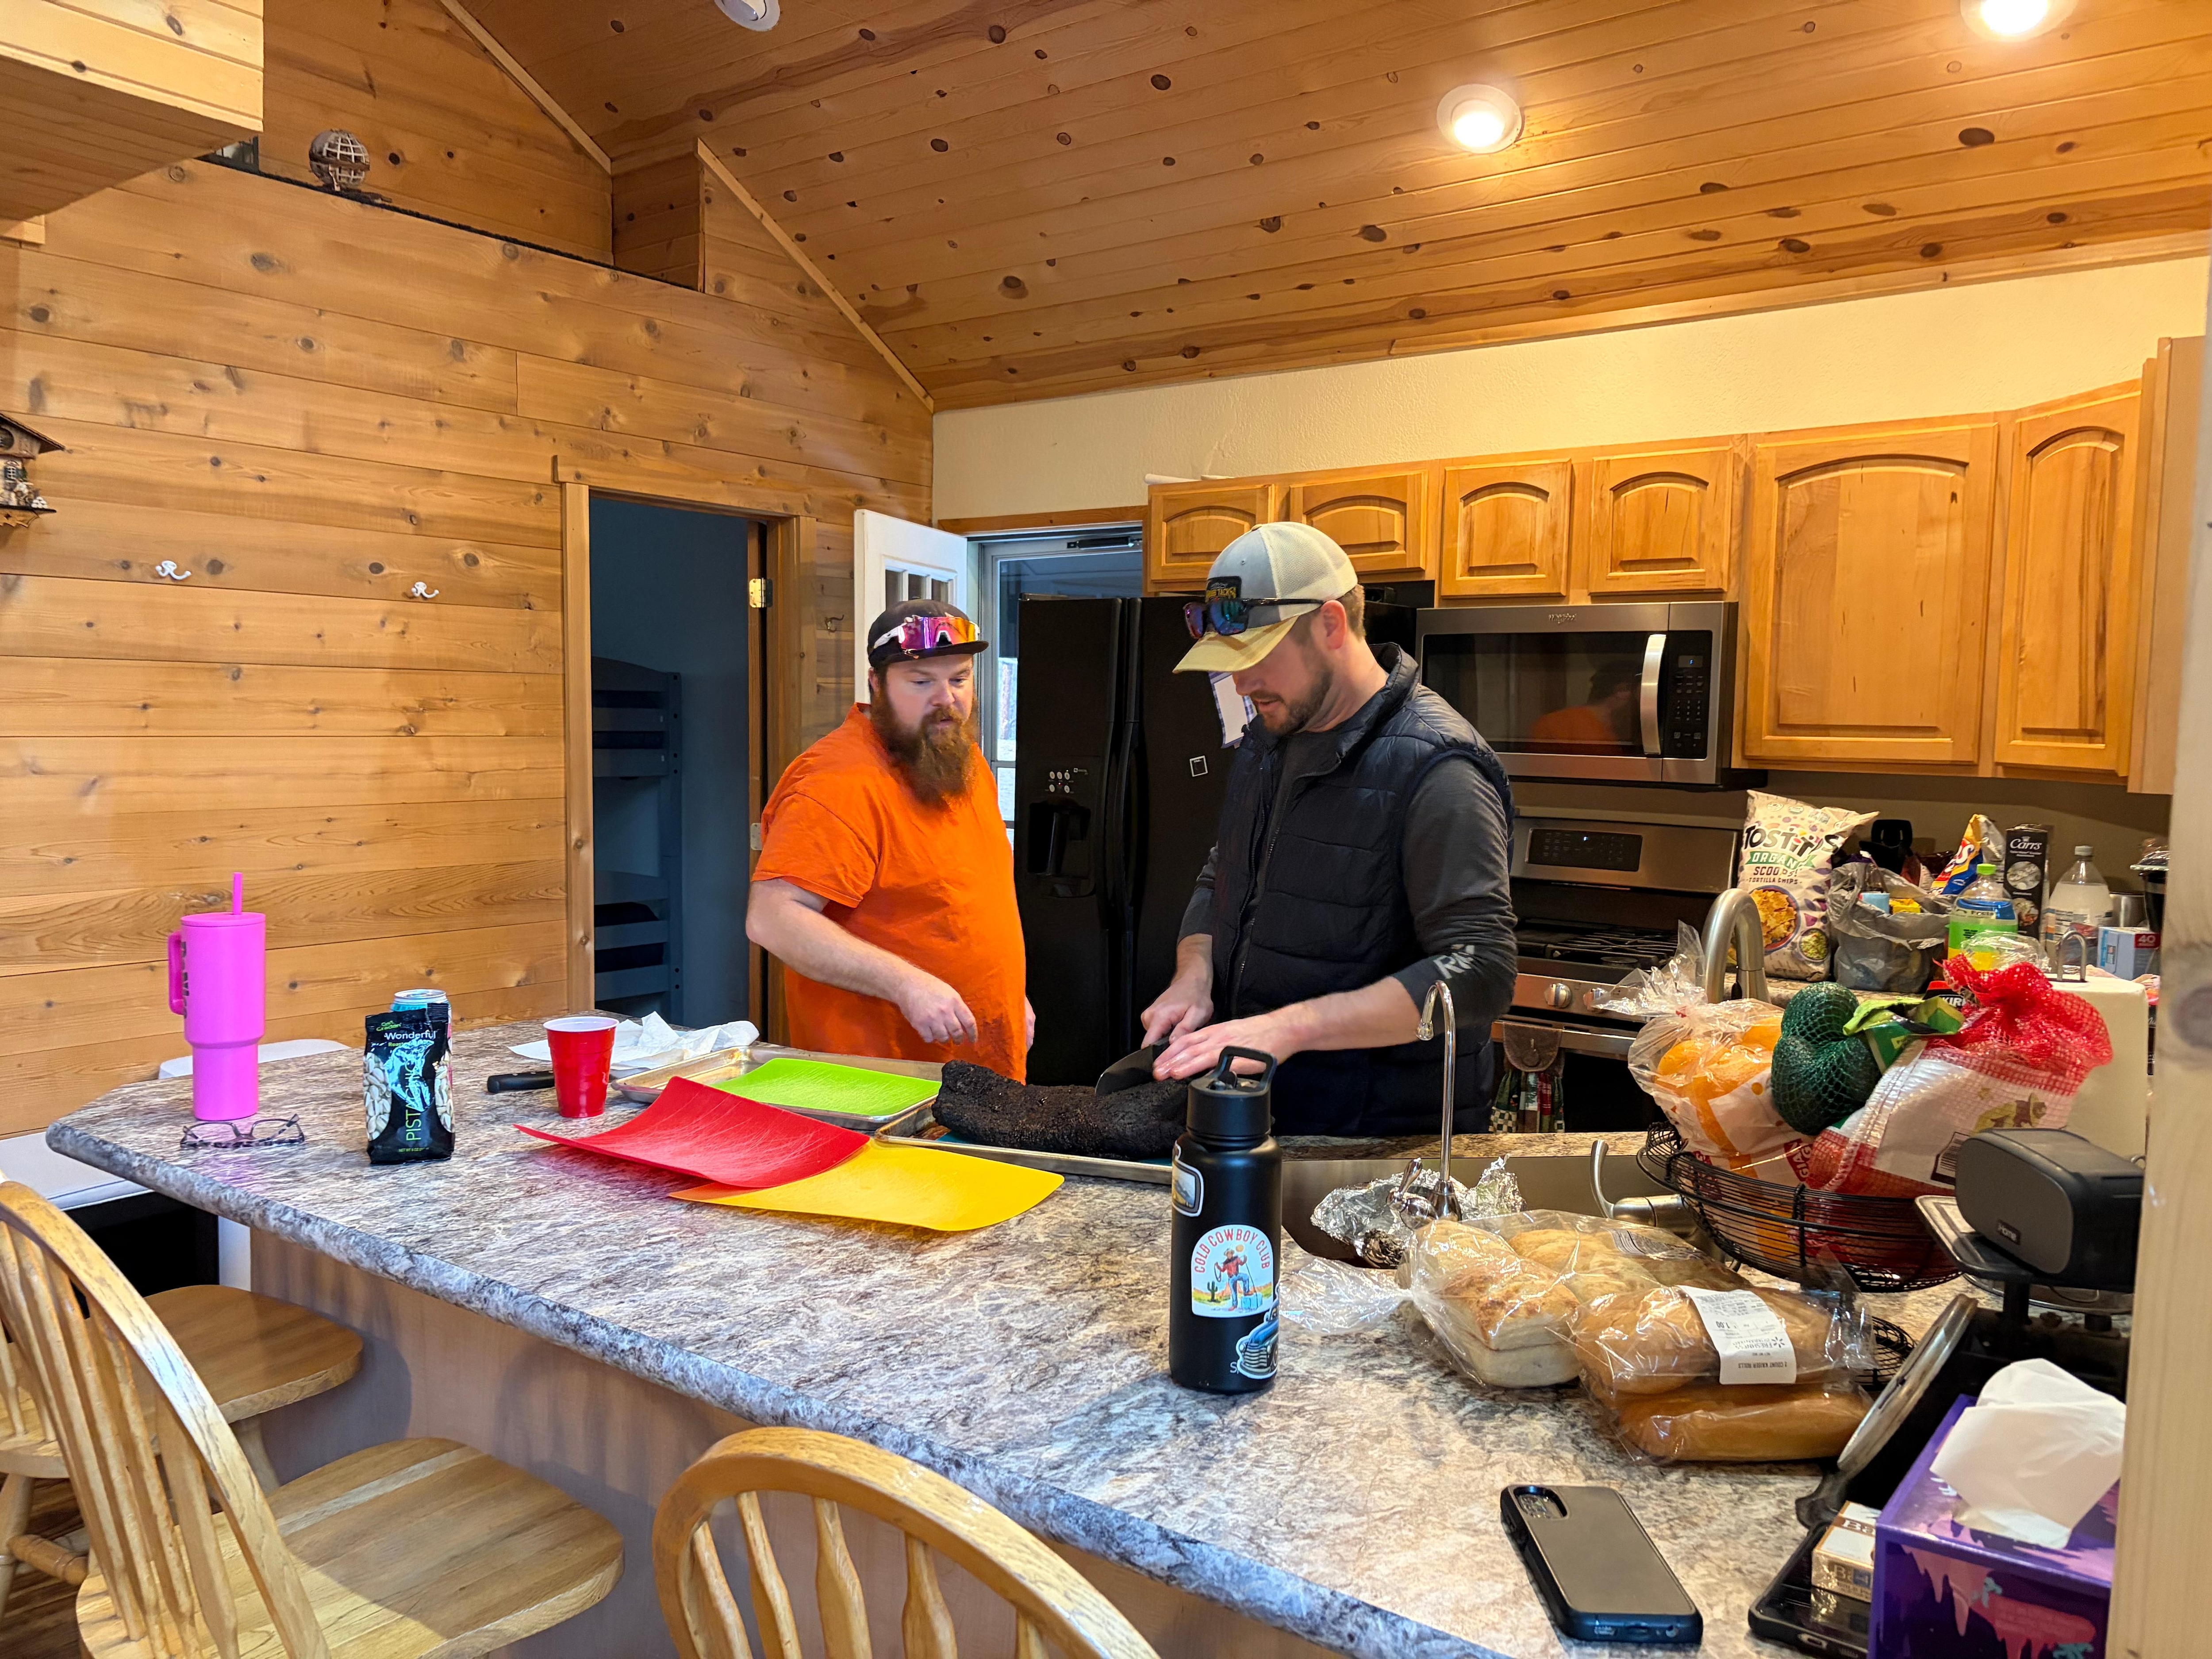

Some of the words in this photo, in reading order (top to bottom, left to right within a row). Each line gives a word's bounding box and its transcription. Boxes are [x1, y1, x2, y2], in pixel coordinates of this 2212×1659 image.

[1752, 852, 1806, 868] ORGAN
[384, 1030, 436, 1040] Wonderful
[1194, 1244, 1210, 1273] COLD
[1208, 1228, 1258, 1247] COWBOY
[1256, 1240, 1271, 1269] CLUB
